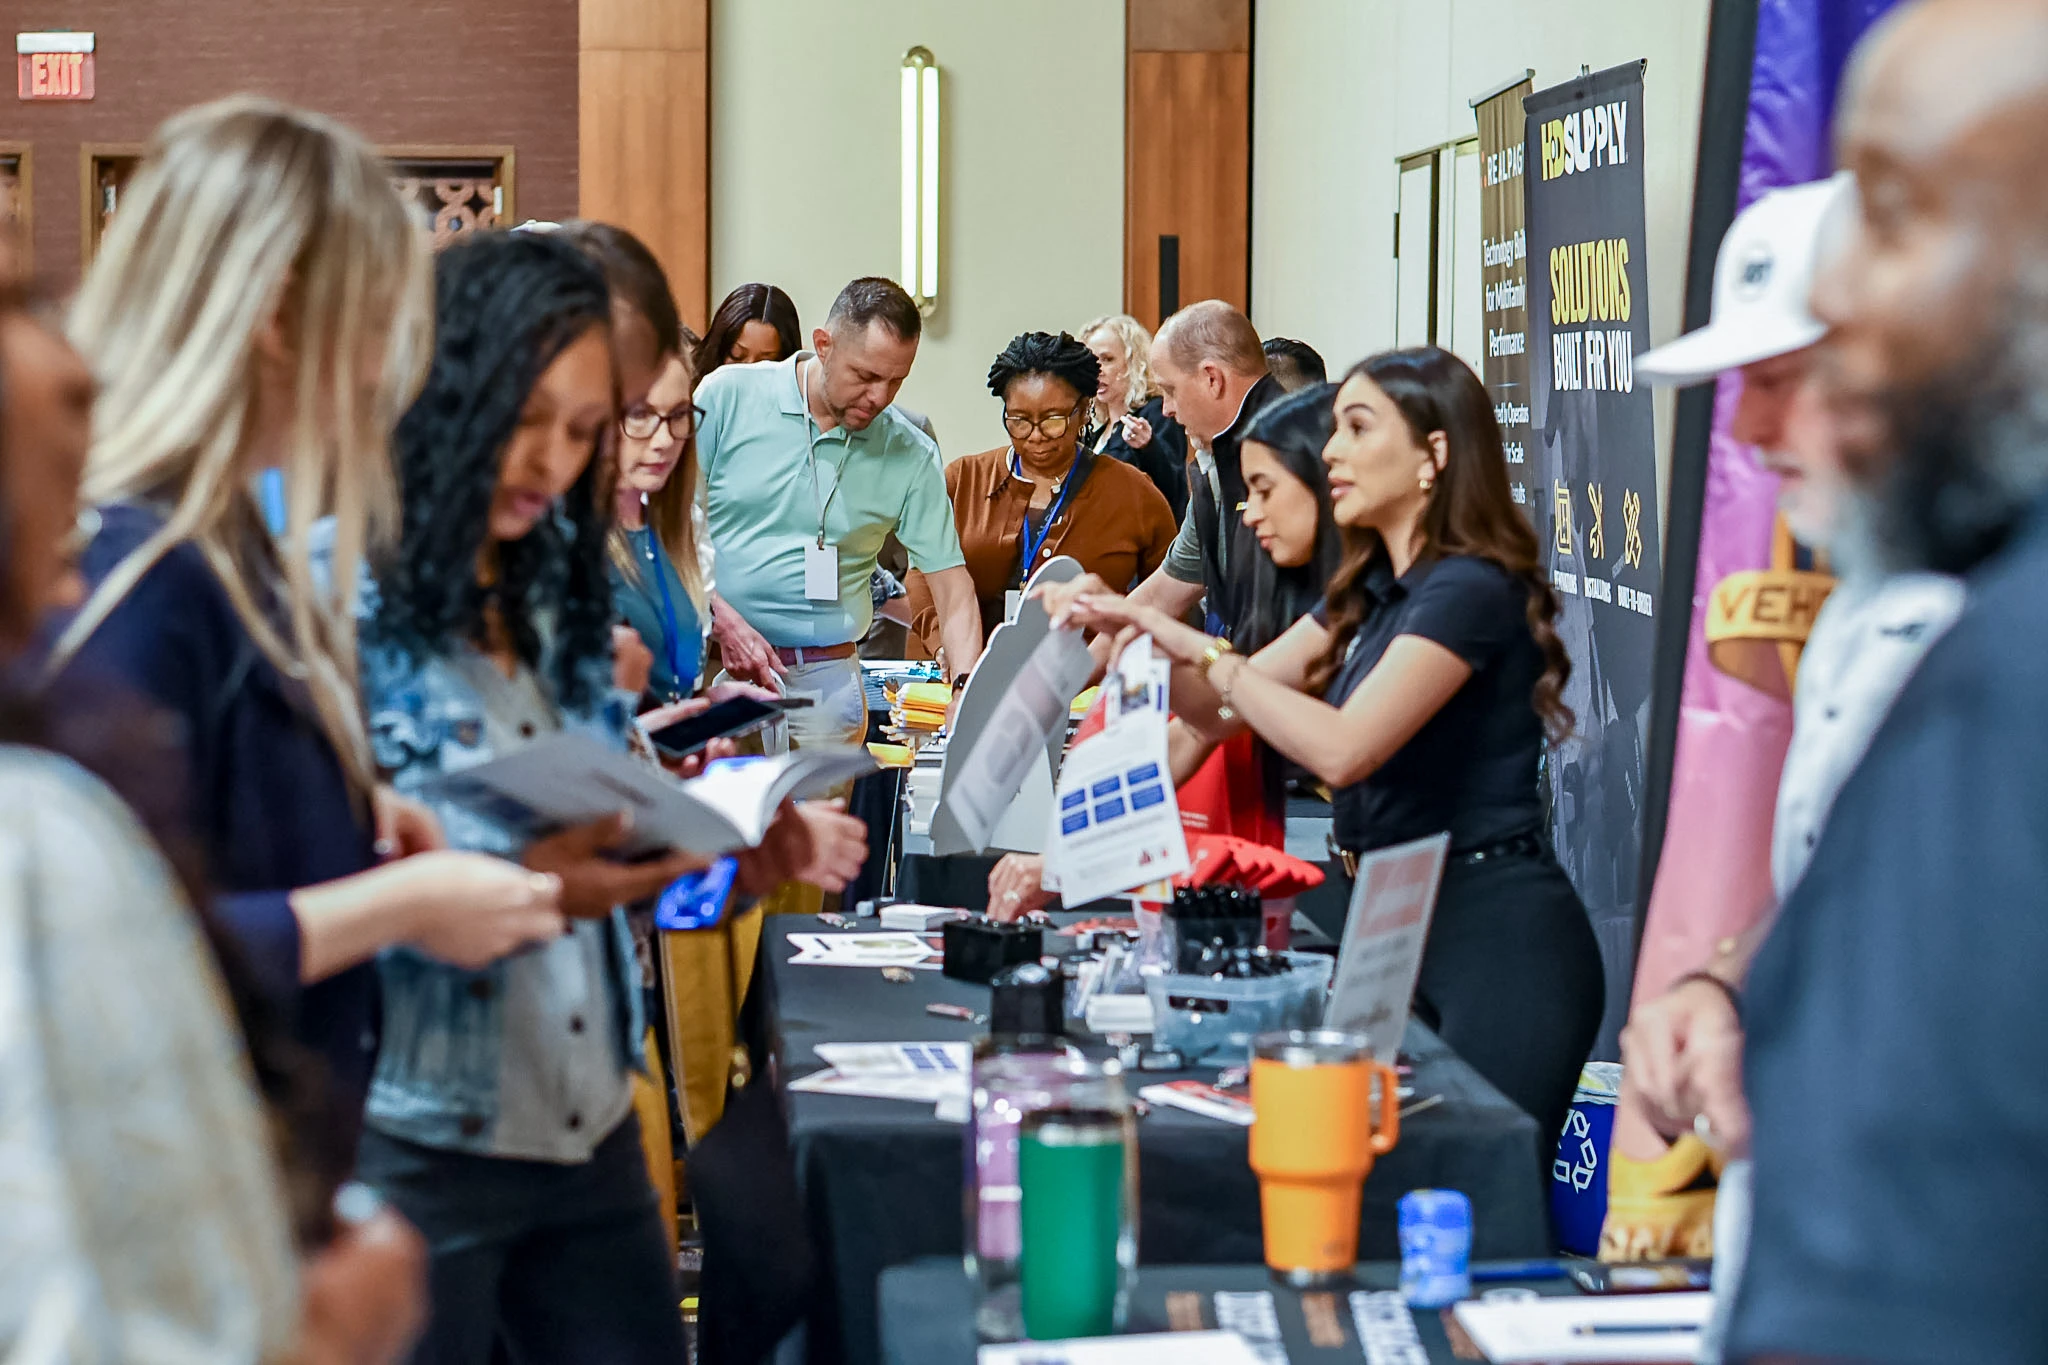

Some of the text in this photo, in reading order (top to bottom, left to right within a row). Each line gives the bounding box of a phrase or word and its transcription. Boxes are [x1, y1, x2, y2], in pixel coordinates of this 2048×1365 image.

[31, 53, 84, 96] EXIT
[1514, 228, 1527, 260] Buil
[1553, 330, 1633, 394] BUILT FR YOU
[1717, 584, 1833, 624] VEH
